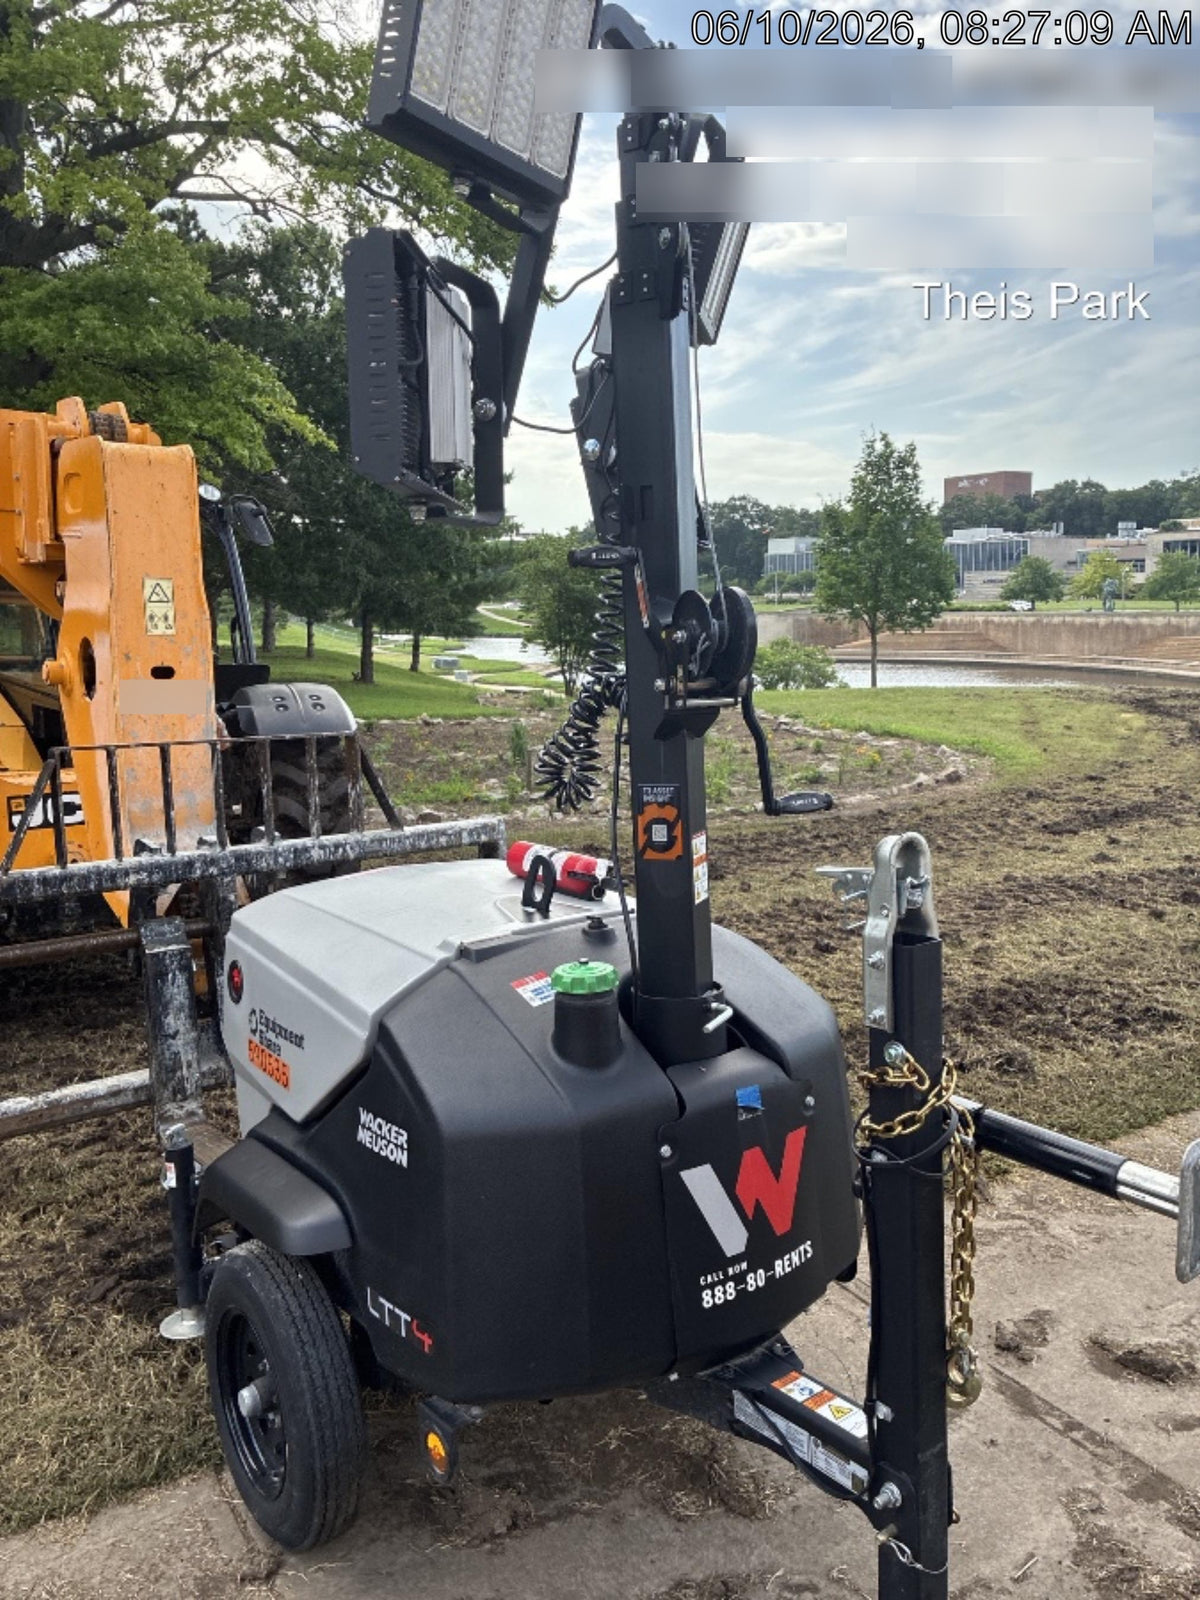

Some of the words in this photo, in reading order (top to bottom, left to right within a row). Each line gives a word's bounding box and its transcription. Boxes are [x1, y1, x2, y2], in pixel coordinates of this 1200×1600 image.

[259, 1008, 304, 1050] Equipment
[357, 1125, 408, 1169] NEUSON
[359, 1106, 408, 1149] WACKER
[700, 1271, 724, 1286] CALL
[727, 1261, 748, 1276] NOW
[701, 1240, 813, 1309] 888-80-RENTS
[367, 1287, 433, 1354] LTT4
